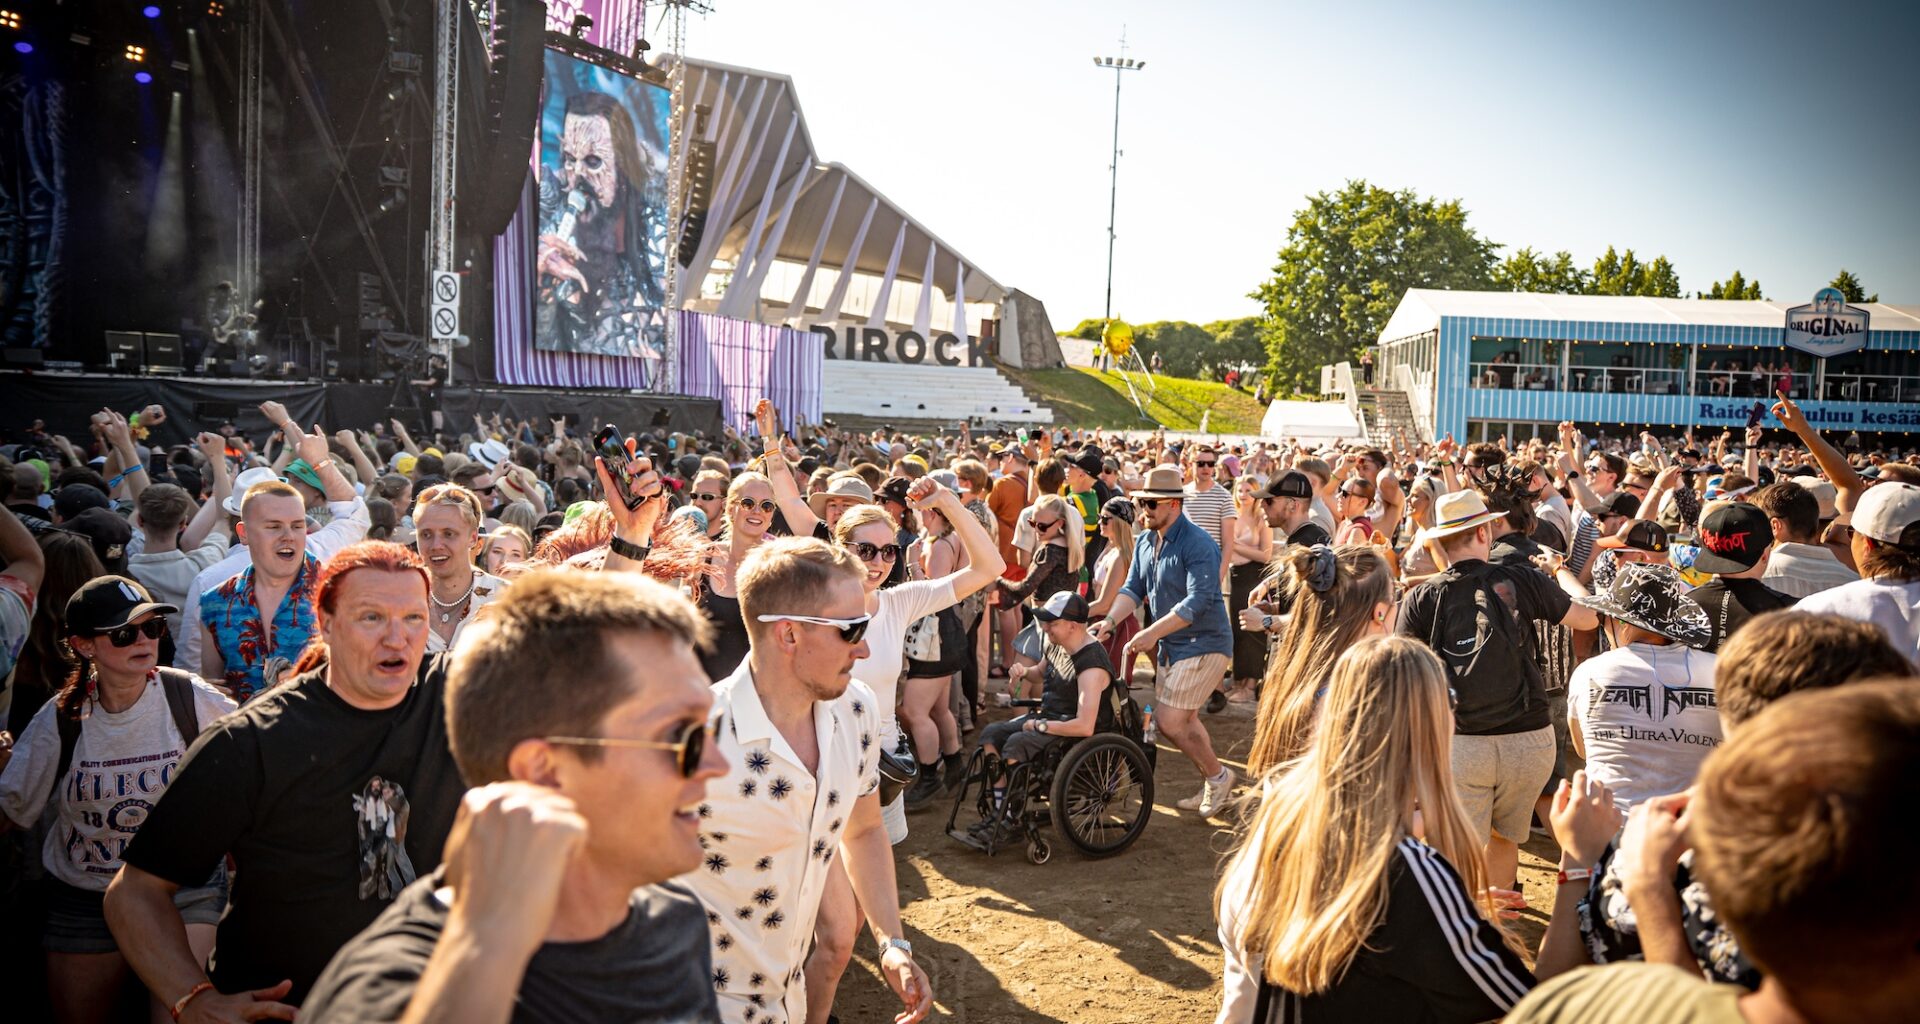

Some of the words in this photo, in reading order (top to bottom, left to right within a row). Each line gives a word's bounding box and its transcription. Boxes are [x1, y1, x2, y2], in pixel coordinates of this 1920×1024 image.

[1790, 317, 1863, 336] ORIGINAL
[782, 324, 994, 367] RIROCK
[1699, 403, 1768, 420] Raidt
[1659, 683, 1718, 723] ANGE
[1620, 725, 1724, 748] ULTRA-VIOLENC
